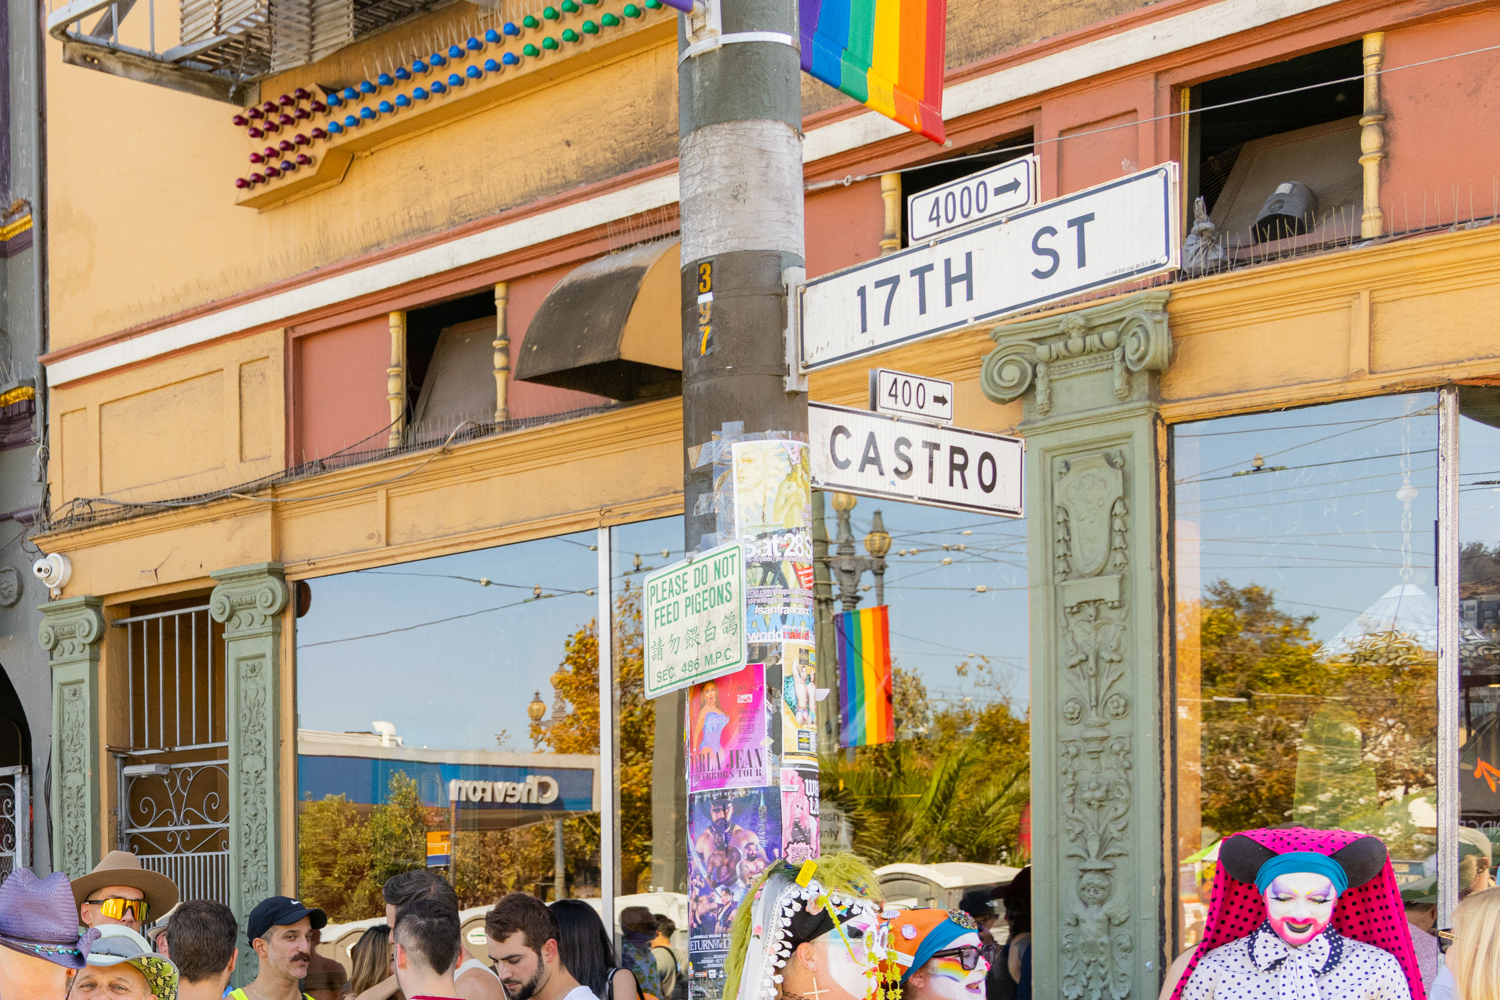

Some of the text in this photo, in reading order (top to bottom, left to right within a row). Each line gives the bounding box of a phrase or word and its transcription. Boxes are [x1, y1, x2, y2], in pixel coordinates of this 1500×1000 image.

[928, 180, 988, 228] 4000
[856, 212, 1095, 334] 17TH ST
[888, 377, 926, 409] 400
[829, 425, 997, 493] CASTRO
[742, 533, 781, 558] Sat
[650, 554, 737, 606] PLEASE DO NOT
[654, 601, 679, 629] FEED
[685, 582, 732, 617] PIGEONS
[657, 648, 735, 683] SEC. 486 M.P.C.
[726, 748, 763, 769] JEAN
[737, 768, 763, 777] TOUR
